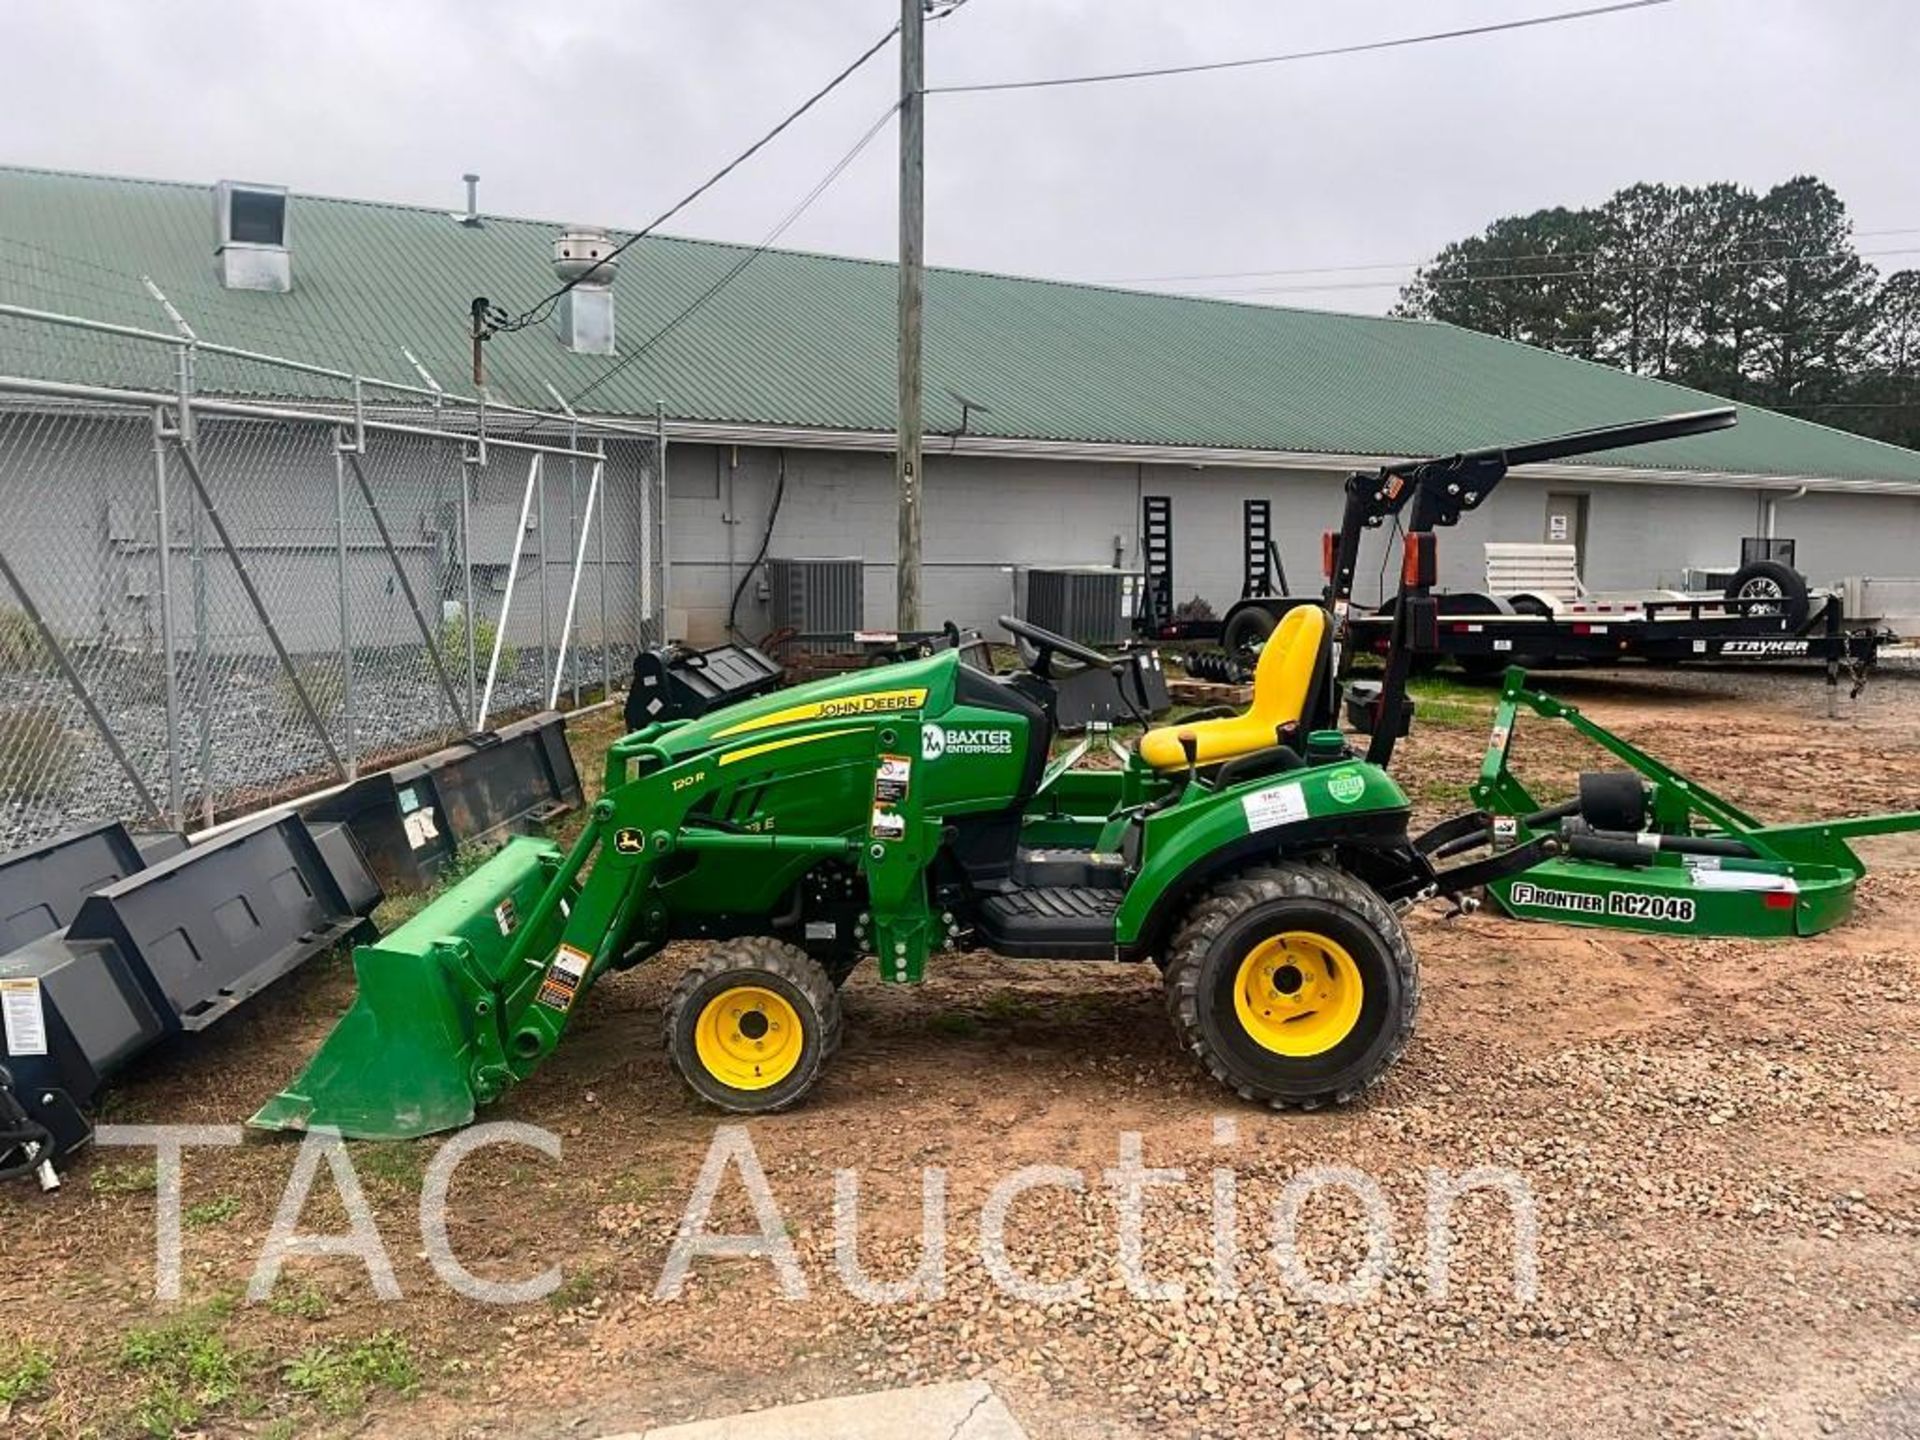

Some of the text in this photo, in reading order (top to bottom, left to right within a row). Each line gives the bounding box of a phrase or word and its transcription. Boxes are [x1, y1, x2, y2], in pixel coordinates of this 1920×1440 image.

[1721, 640, 1809, 654] STRYKER
[818, 696, 918, 717] JOHN DEERE
[946, 730, 1012, 744] BAXTER
[946, 745, 1012, 754] ENTERPRISES
[671, 776, 695, 792] 120
[1511, 882, 1695, 922] FRONTIER RC2048
